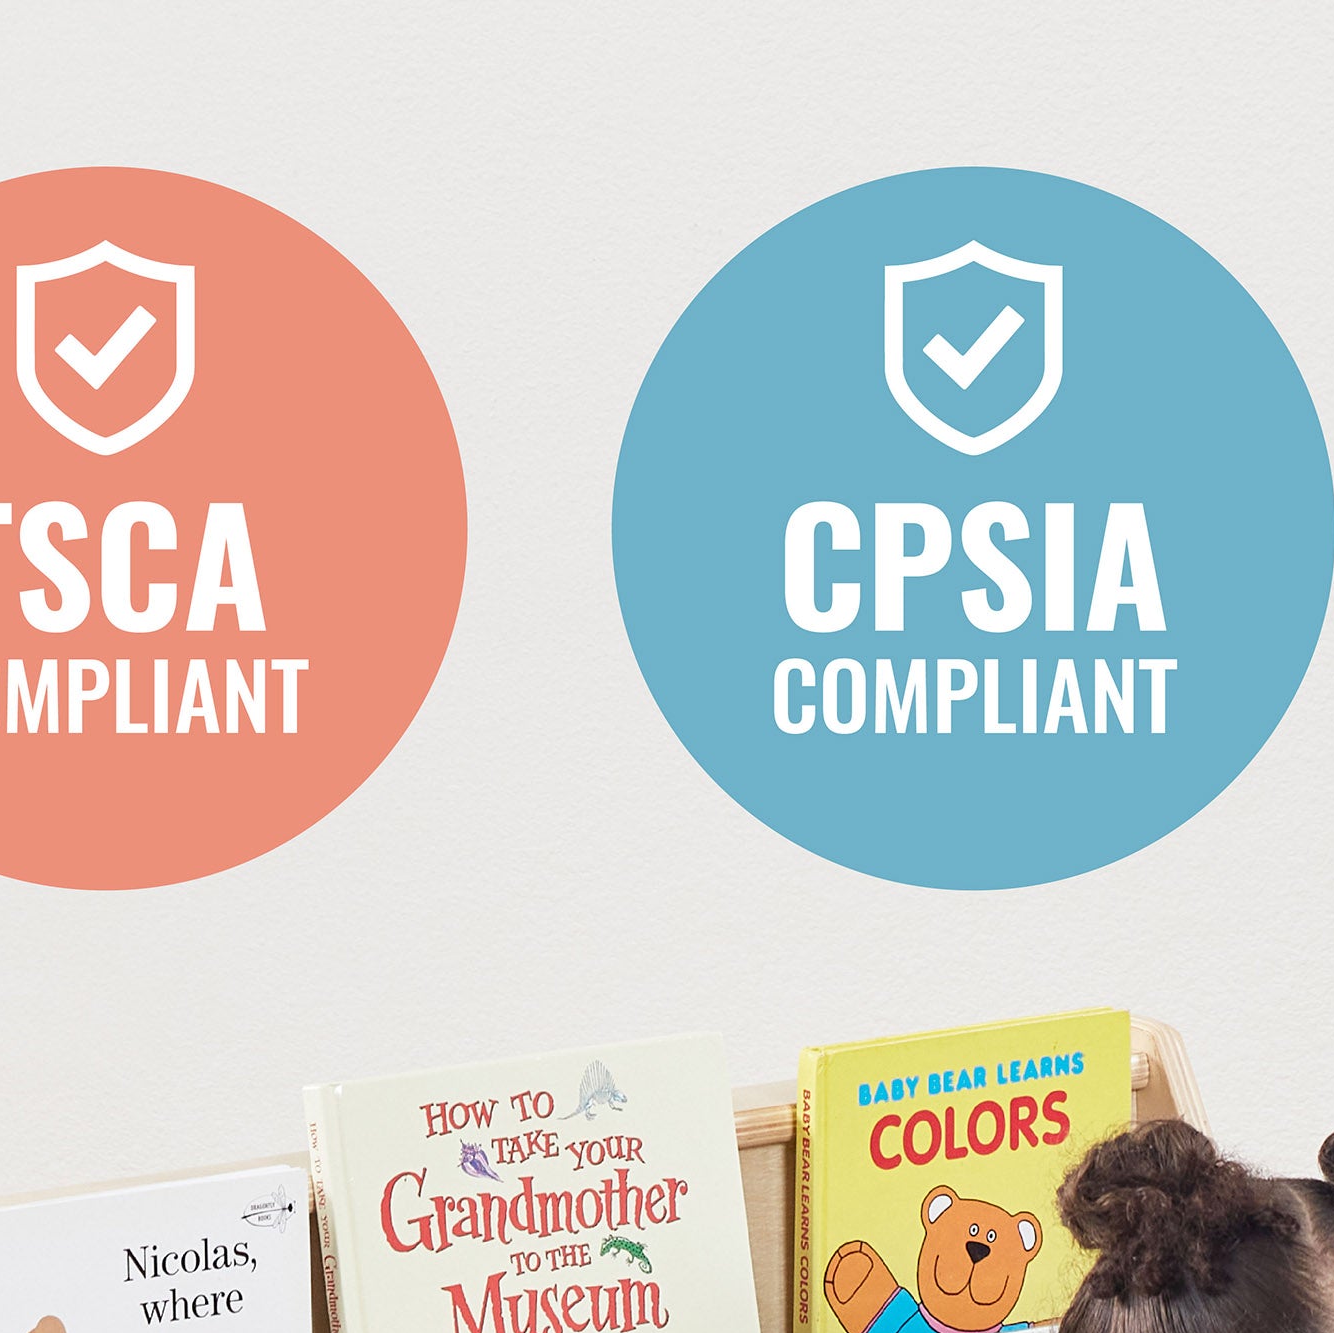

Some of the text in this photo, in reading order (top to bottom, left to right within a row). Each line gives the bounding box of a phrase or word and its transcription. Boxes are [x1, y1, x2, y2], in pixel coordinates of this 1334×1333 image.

[858, 1051, 1085, 1107] BABY BEAR LEARNS
[511, 1090, 555, 1121] TO
[492, 1129, 559, 1165] TAKE
[870, 1090, 1071, 1170] COLORS
[380, 1167, 689, 1254] Grandmother
[798, 1089, 812, 1325] BABY BEAR LEARNS COLORS
[123, 1238, 258, 1282] Nicolas,
[510, 1242, 592, 1276] TO THE
[140, 1286, 244, 1326] where
